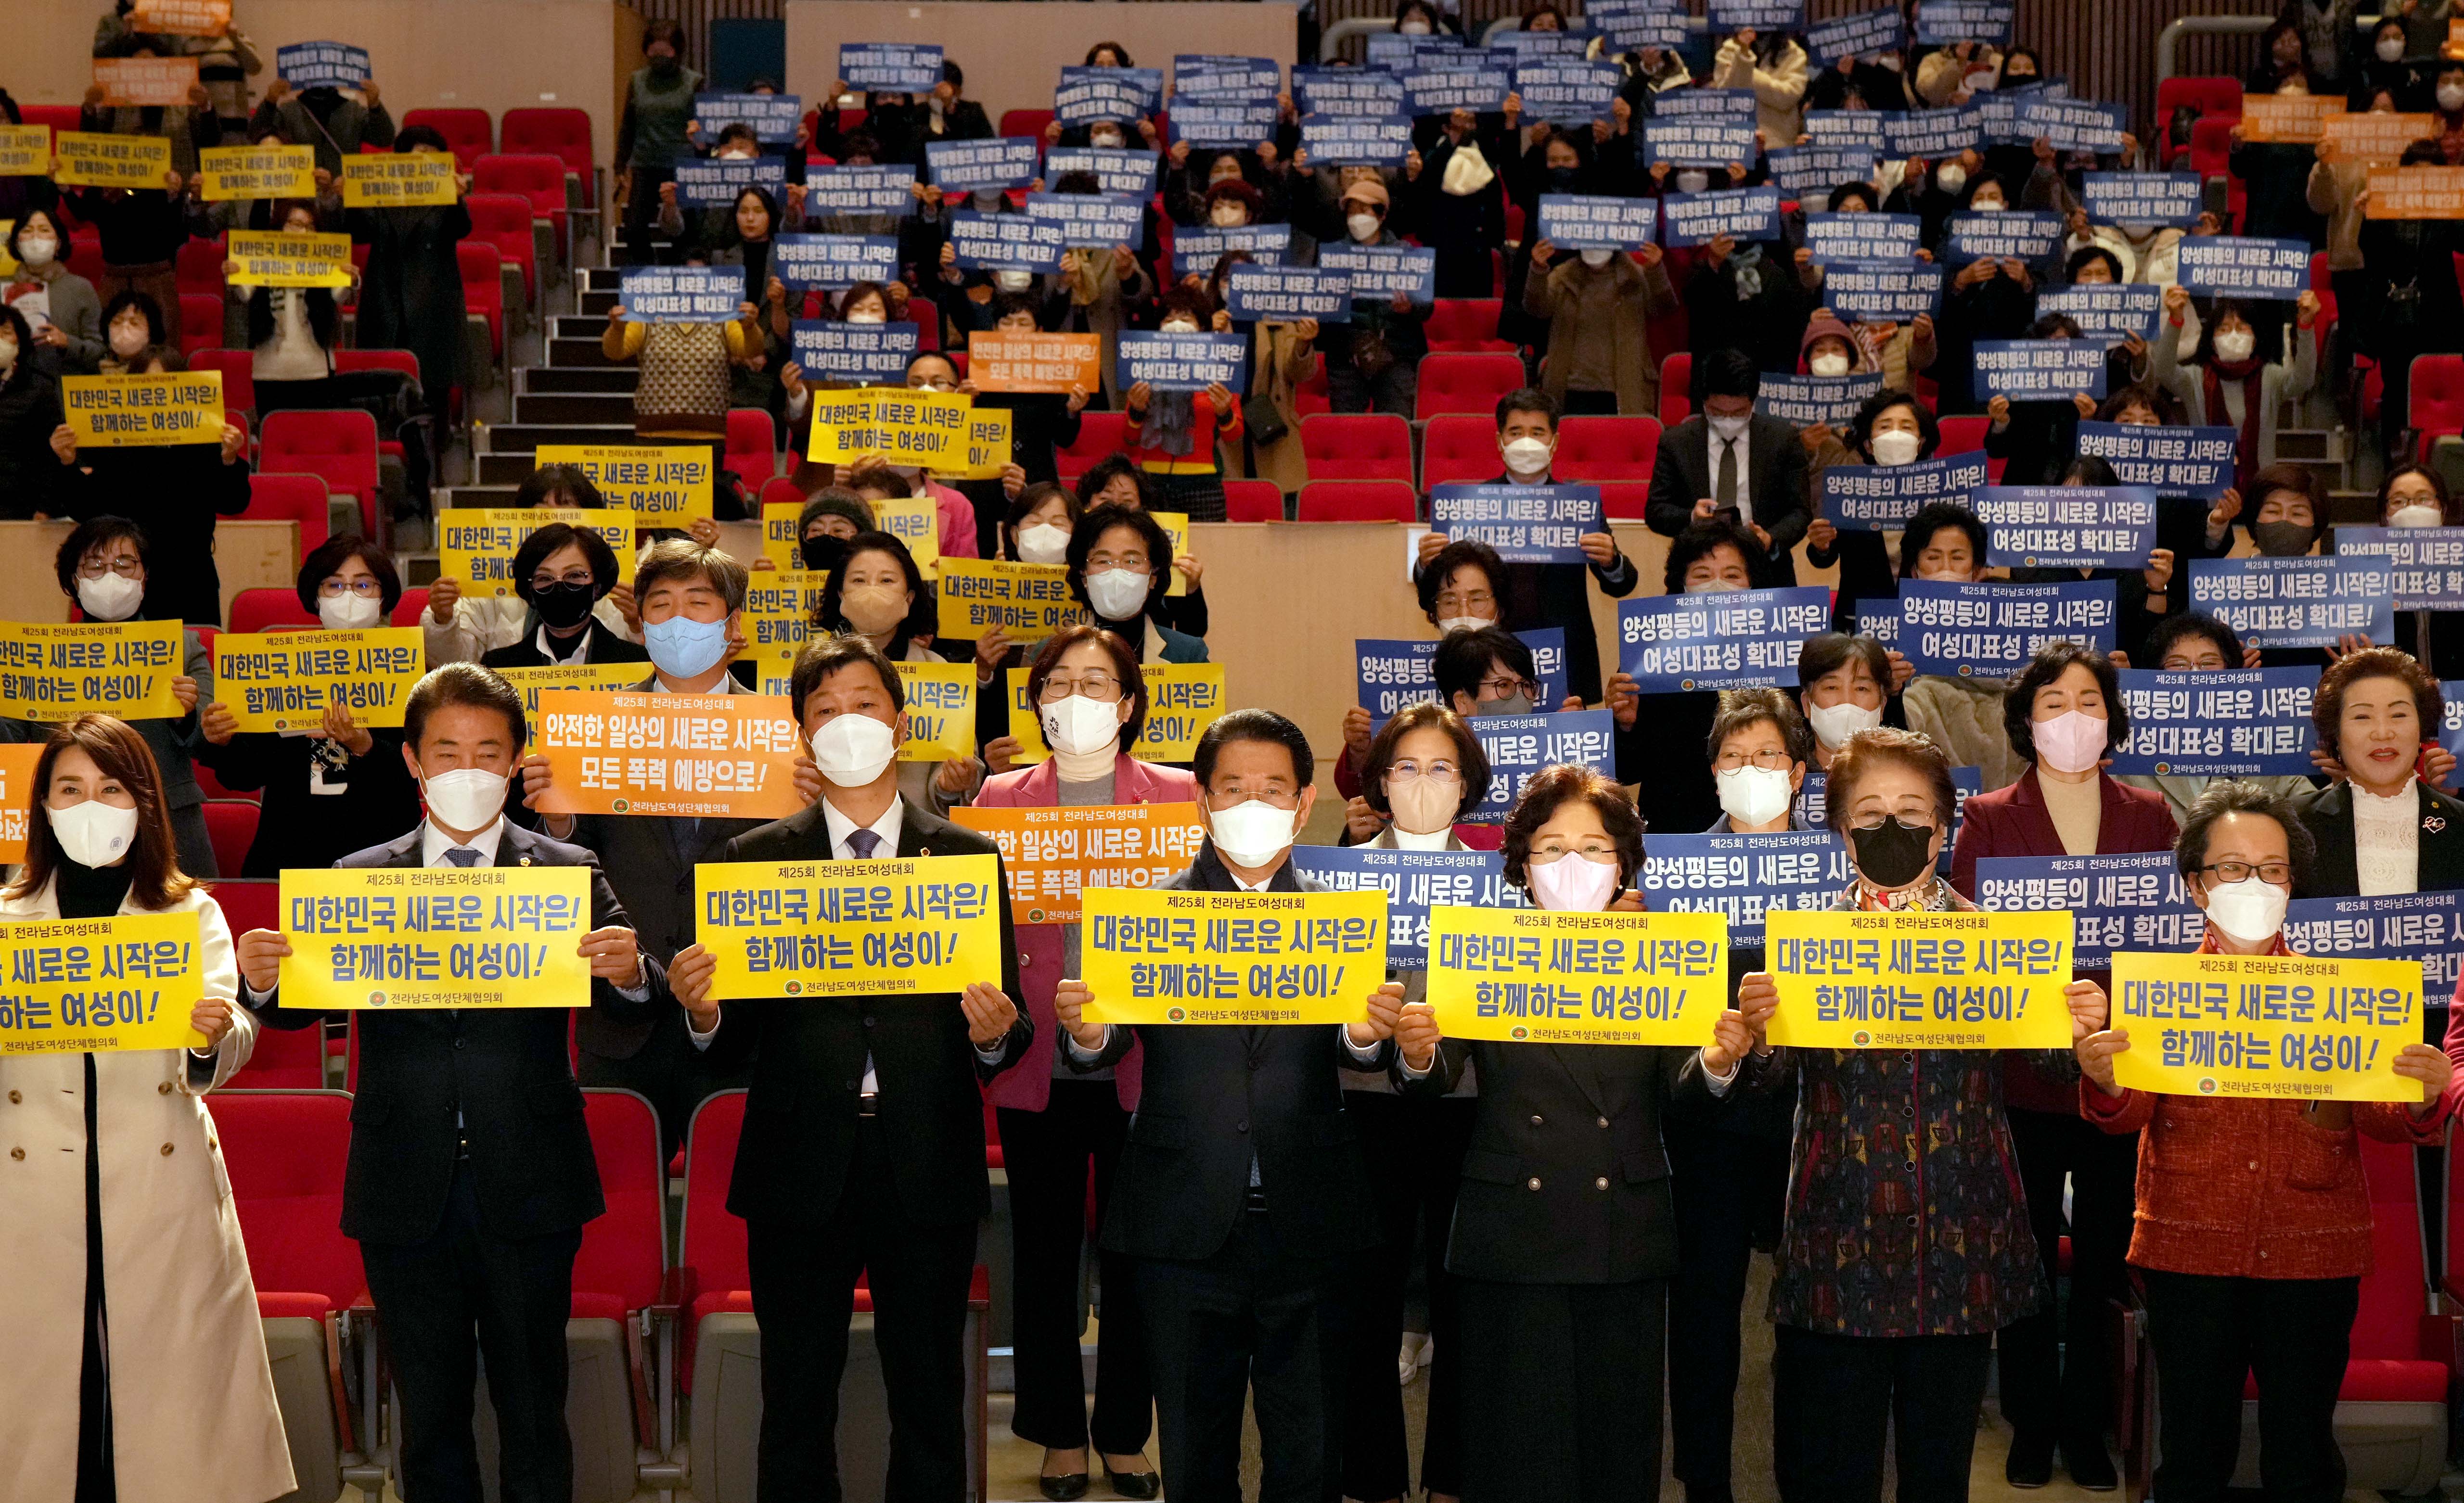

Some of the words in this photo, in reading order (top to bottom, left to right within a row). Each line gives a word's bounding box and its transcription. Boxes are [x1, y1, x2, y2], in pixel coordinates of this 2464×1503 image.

[69, 389, 122, 408] 대한민국
[127, 387, 167, 407] 새로운
[172, 385, 217, 405] 시작은!
[90, 413, 147, 433] 함께하는
[152, 410, 201, 430] 여성이!
[819, 403, 870, 424] 대한민국
[874, 403, 915, 425] 새로운
[920, 406, 965, 429] 시작은!
[838, 428, 893, 449] 함께하는
[898, 430, 948, 452] 여성이!
[2080, 434, 2143, 458] 양성평등의
[2146, 439, 2185, 461] 새로운
[2189, 441, 2233, 461] 시작은!
[604, 463, 649, 484] 새로운
[654, 463, 706, 484] 시작은!
[2168, 464, 2218, 485] 확대로!
[630, 492, 687, 512] 여성이!
[2023, 489, 2045, 497] 제25회
[2049, 488, 2105, 497] 전라남도여성대회
[1435, 498, 1502, 521] 양성평등의
[1505, 499, 1547, 521] 새로운
[1550, 499, 1597, 522] 시작은!
[1977, 500, 2049, 524] 양성평등의
[2053, 501, 2097, 524] 새로운
[2102, 502, 2153, 524] 시작은!
[1993, 529, 2075, 552] 여성대표성
[2081, 529, 2138, 552] 확대로!
[2038, 558, 2104, 566] 전라남도여성단체협의회
[2245, 560, 2270, 570] 제25회
[2273, 559, 2336, 569] 전라남도여성대회
[945, 575, 1010, 600] 대한민국
[1016, 579, 1065, 600] 새로운
[2194, 574, 2273, 601] 양성평등의
[2279, 573, 2327, 598] 새로운
[2333, 572, 2388, 597] 시작은!
[1676, 598, 1703, 606] 제25회
[1707, 592, 1773, 605] 전라남도여성대회
[970, 604, 1037, 628] 함께하는
[1623, 611, 1707, 643] 양성평등의
[1714, 608, 1765, 636] 새로운
[1771, 605, 1827, 633] 시작은!
[2310, 603, 2373, 629] 확대로!
[22, 627, 48, 636] 제25회
[53, 627, 121, 636] 전라남도여성대회
[266, 637, 293, 646] 제25회
[297, 632, 363, 644] 전라남도여성대회
[2262, 635, 2336, 645] 전라남도여성단체협의회
[49, 642, 105, 668] 새로운
[112, 640, 176, 667] 시작은!
[221, 653, 289, 680] 대한민국
[295, 649, 350, 676] 새로운
[356, 647, 417, 674] 시작은!
[1643, 643, 1740, 674] 여성대표성
[2, 673, 76, 702] 함께하는
[83, 675, 153, 701] 여성이!
[1697, 677, 1775, 688] 전라남도여성단체협의회
[2156, 674, 2184, 684] 제25회
[2190, 672, 2262, 684] 전라남도여성대회
[245, 685, 323, 713] 함께하는
[613, 696, 646, 708] 제25회
[652, 697, 734, 710] 전라남도여성대회
[2196, 689, 2253, 719] 새로운
[546, 713, 604, 747] 안전한
[609, 715, 665, 749] 일상의
[670, 717, 728, 751] 새로운
[733, 719, 800, 752] 시작은!
[2231, 726, 2304, 755] 확대로!
[580, 757, 620, 790] 모든
[627, 758, 666, 791] 폭력
[674, 759, 767, 792] 예방으로!
[2172, 764, 2260, 773] 전라남도여성단체협의회
[632, 802, 729, 814] 전라남도여성단체협의회
[1025, 812, 1058, 823] 제25회
[1064, 809, 1147, 822] 전라남도여성대회
[1022, 830, 1078, 861] 일상의
[1085, 828, 1142, 859] 새로운
[366, 874, 404, 886] 제25회
[411, 873, 504, 885] 전라남도여성대회
[778, 866, 815, 879] 제25회
[821, 863, 913, 877] 전라남도여성대회
[1042, 869, 1080, 900] 폭력
[292, 896, 396, 933] 대한민국
[404, 895, 482, 932] 새로운
[490, 894, 580, 931] 시작은!
[707, 889, 808, 926] 대한민국
[817, 886, 893, 923] 새로운
[901, 883, 988, 920] 시작은!
[1167, 896, 1204, 908] 제25회
[1211, 897, 1304, 909] 전라남도여성대회
[14, 922, 111, 939] 전라남도여성대회
[1094, 915, 1196, 954] 대한민국
[1204, 919, 1281, 954] 새로운
[1289, 918, 1377, 953] 시작은!
[1513, 915, 1550, 928] 제25회
[1556, 917, 1645, 930] 전라남도여성대회
[1851, 917, 1888, 929] 제25회
[1895, 917, 1988, 930] 전라남도여성대회
[12, 946, 91, 984] 새로운
[100, 941, 190, 979] 시작은!
[331, 943, 440, 981] 함께하는
[450, 943, 547, 980] 여성이!
[745, 934, 853, 972] 함께하는
[863, 931, 957, 968] 여성이!
[1440, 934, 1541, 973] 대한민국
[1549, 938, 1625, 975] 새로운
[1633, 940, 1718, 976] 시작은!
[1778, 938, 1880, 975] 대한민국
[1888, 939, 1965, 975] 새로운
[1974, 939, 2062, 975] 시작은!
[2199, 960, 2237, 973] 제25회
[2244, 961, 2338, 976] 전라남도여성대회
[807, 979, 915, 992] 전라남도여성단체협의회
[1130, 962, 1239, 998] 함께하는
[1248, 964, 1344, 999] 여성이!
[61, 990, 159, 1027] 여성이!
[391, 993, 502, 1004] 전라남도여성단체협의회
[1476, 981, 1582, 1019] 함께하는
[1591, 985, 1686, 1020] 여성이!
[1816, 984, 1924, 1021] 함께하는
[1934, 986, 2029, 1022] 여성이!
[2124, 980, 2229, 1020] 대한민국
[2236, 984, 2315, 1022] 새로운
[2323, 987, 2413, 1025] 시작은!
[1190, 1010, 1299, 1020] 전라남도여성단체협의회
[4, 1037, 117, 1051] 전라남도여성단체협의회
[1532, 1029, 1640, 1041] 전라남도여성단체협의회
[1876, 1033, 1984, 1044] 전라남도여성단체협의회
[2162, 1029, 2271, 1069] 함께하는
[2281, 1033, 2379, 1072] 여성이!
[2221, 1082, 2332, 1095] 전라남도여성단체협의회
